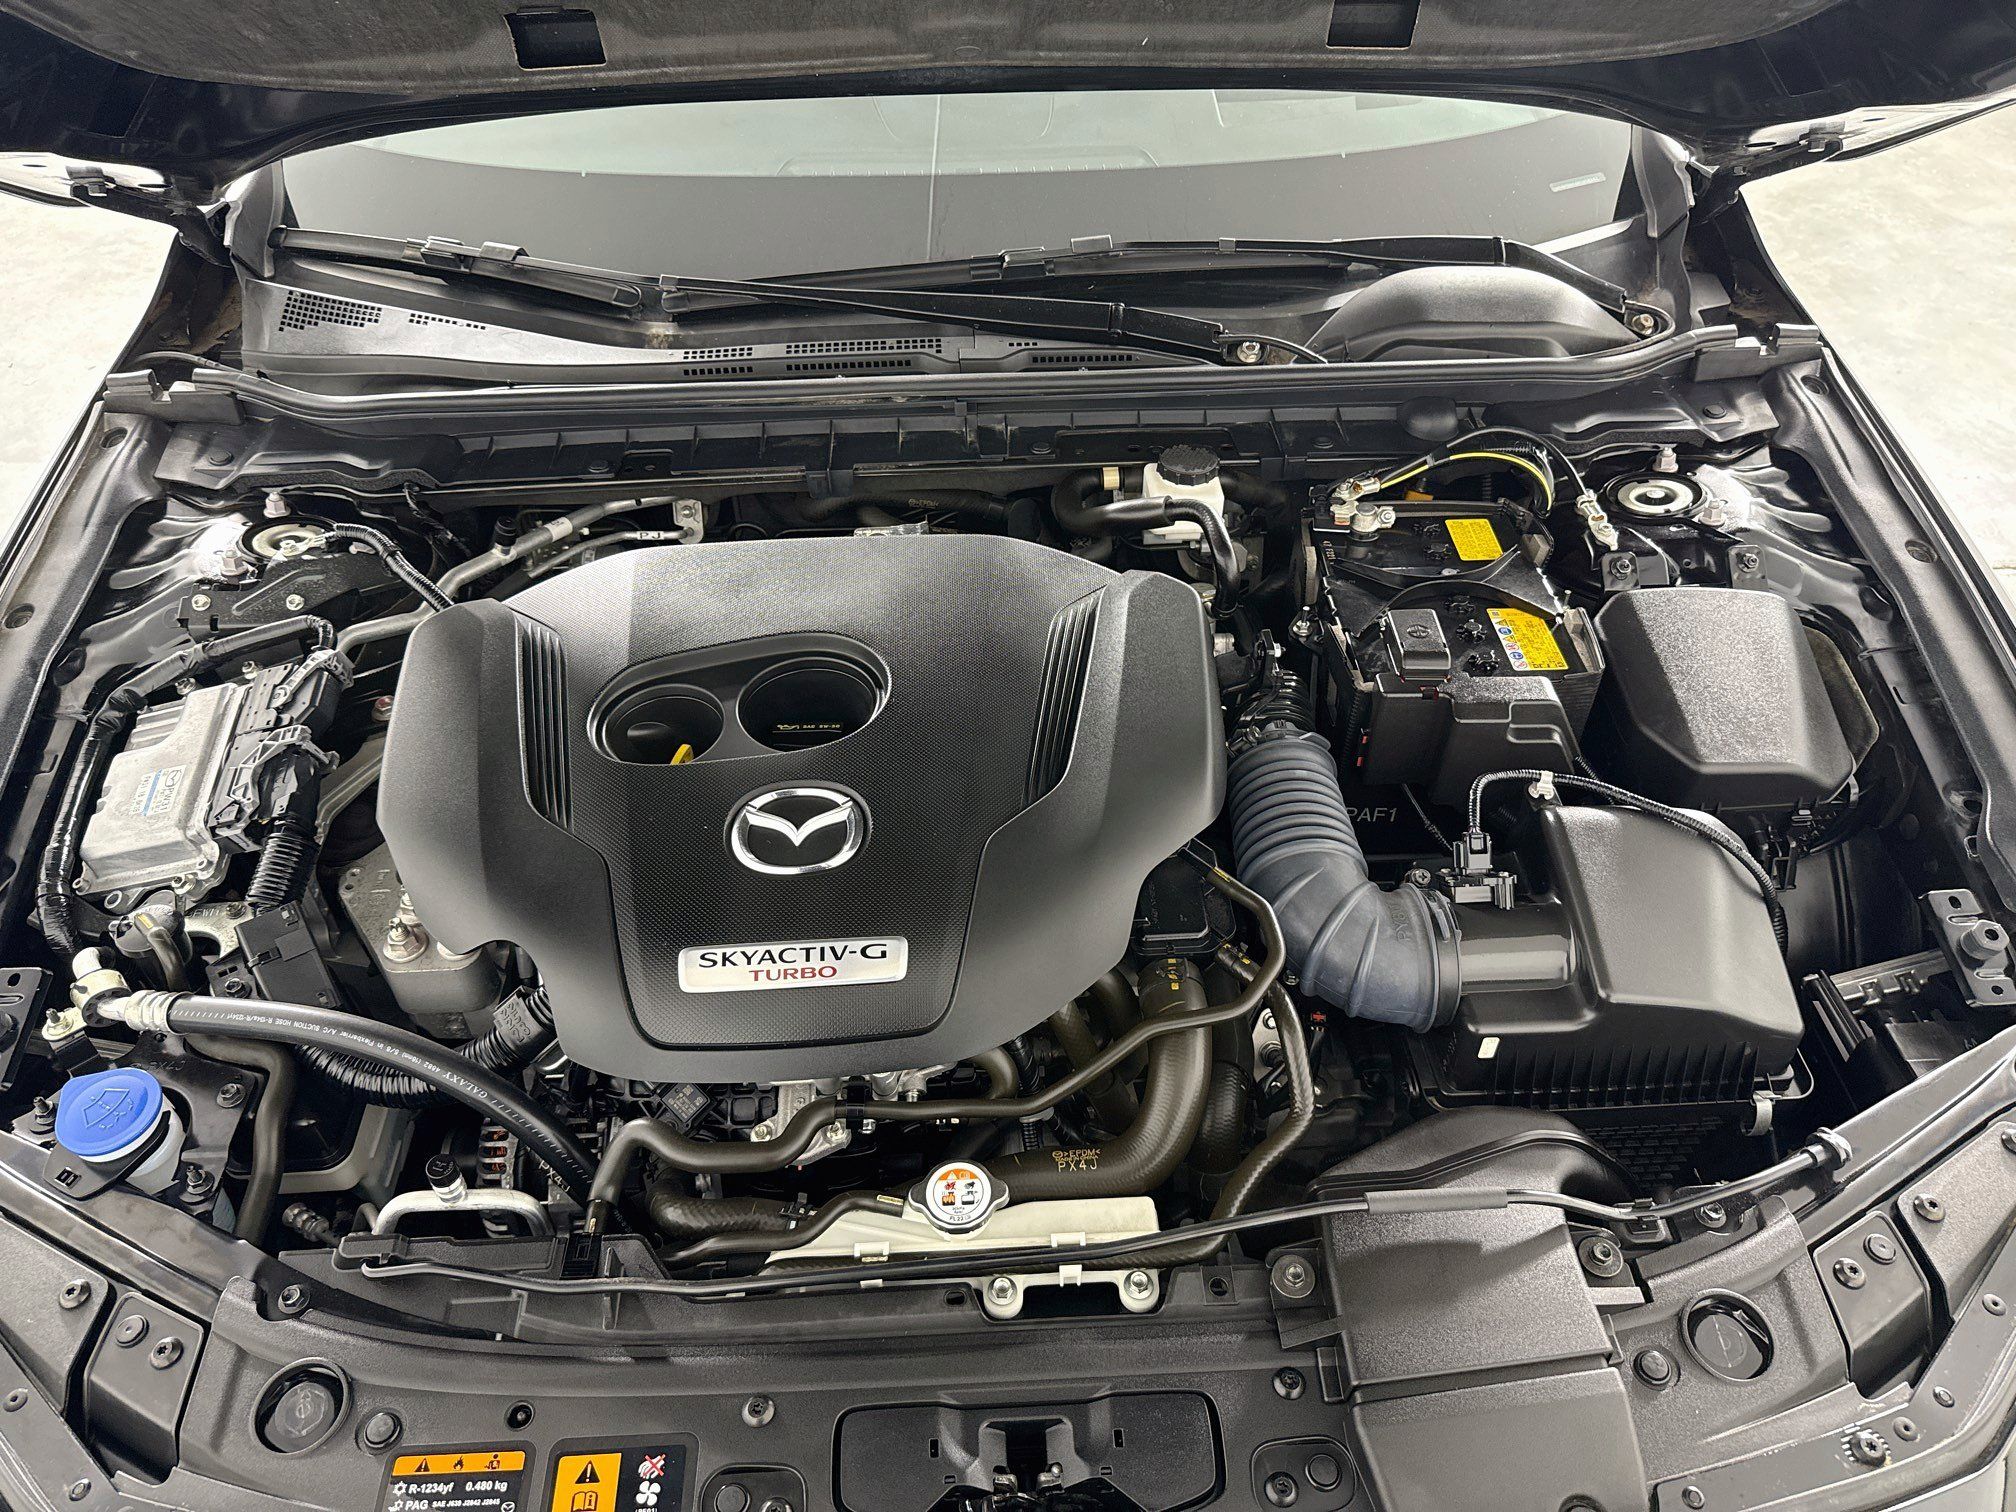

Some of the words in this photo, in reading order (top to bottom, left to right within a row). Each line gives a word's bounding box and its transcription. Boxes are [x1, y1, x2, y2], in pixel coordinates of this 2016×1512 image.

[698, 943, 888, 968] SKYACTIV-G
[749, 965, 838, 982] TURBO
[275, 1017, 291, 1027] HOSE
[292, 1021, 321, 1033] SUCTION
[322, 1026, 337, 1035] A/C
[340, 1030, 375, 1047] Flexbarrier
[443, 1071, 488, 1099] GALAXY
[1057, 1158, 1097, 1172] PX4J
[538, 1160, 571, 1192] PX4J
[408, 1482, 454, 1495] R-1234yf
[465, 1481, 493, 1492] 0.480
[494, 1480, 508, 1492] kg
[405, 1499, 429, 1511] PAG
